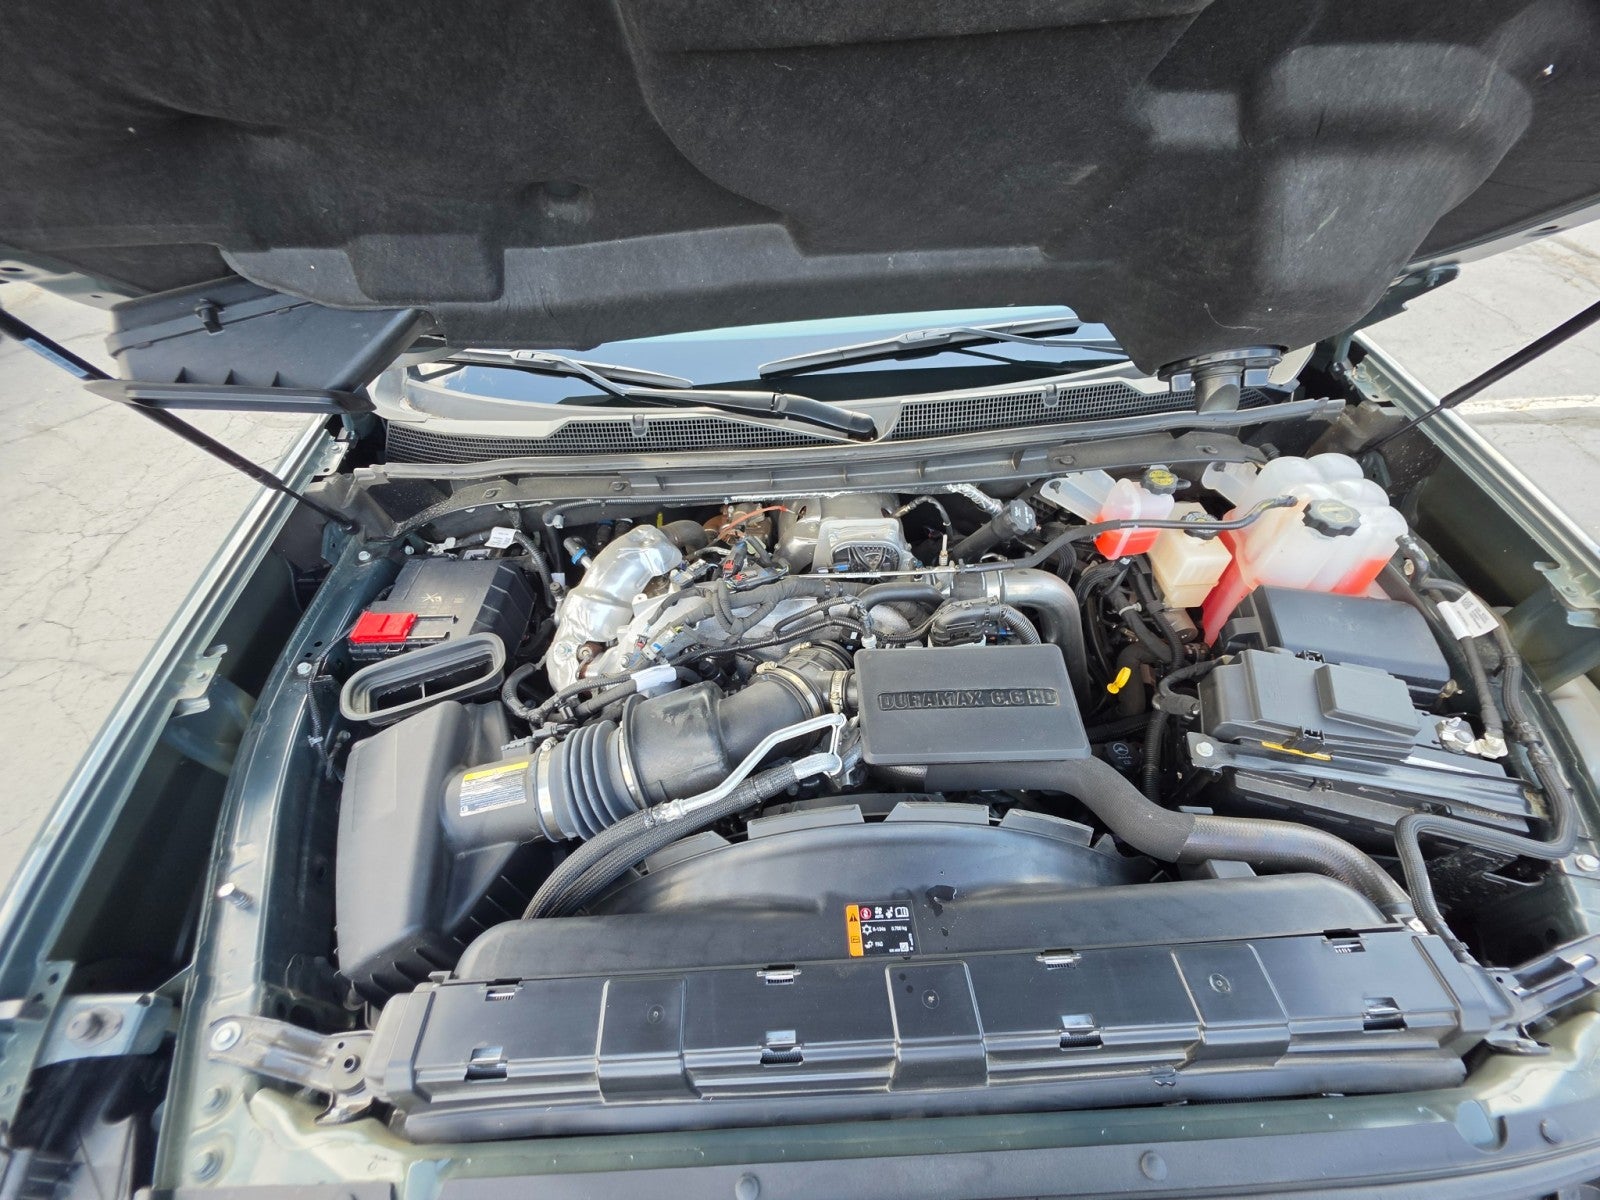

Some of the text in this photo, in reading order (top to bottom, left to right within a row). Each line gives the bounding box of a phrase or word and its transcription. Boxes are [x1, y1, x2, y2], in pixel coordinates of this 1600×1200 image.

[879, 689, 1058, 710] DURAMAX 6.6 HD
